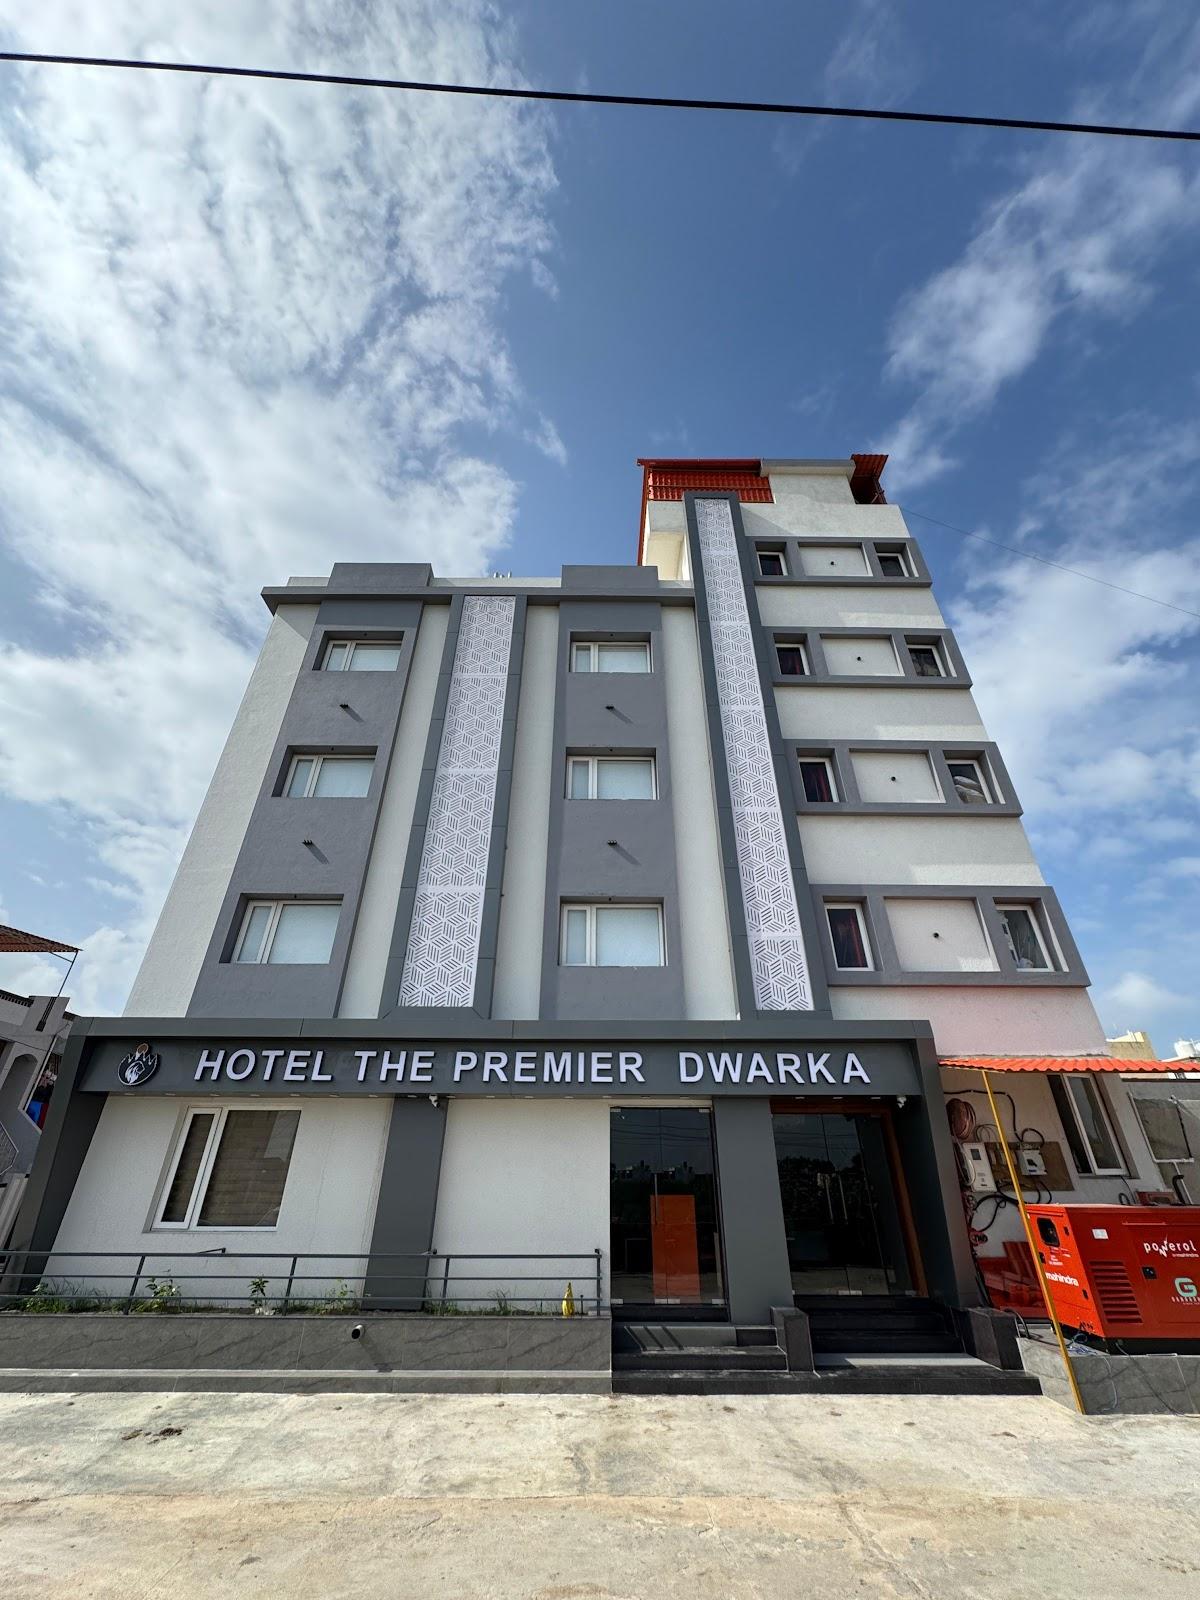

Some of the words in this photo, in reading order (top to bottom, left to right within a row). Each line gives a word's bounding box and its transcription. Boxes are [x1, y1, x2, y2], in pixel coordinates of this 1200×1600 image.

[194, 1050, 333, 1082] HOTEL
[354, 1050, 435, 1082] THE
[453, 1051, 645, 1083] PREMIER
[679, 1052, 871, 1084] DWARKA
[1143, 1235, 1197, 1258] powerol
[1045, 1271, 1079, 1287] mahindra
